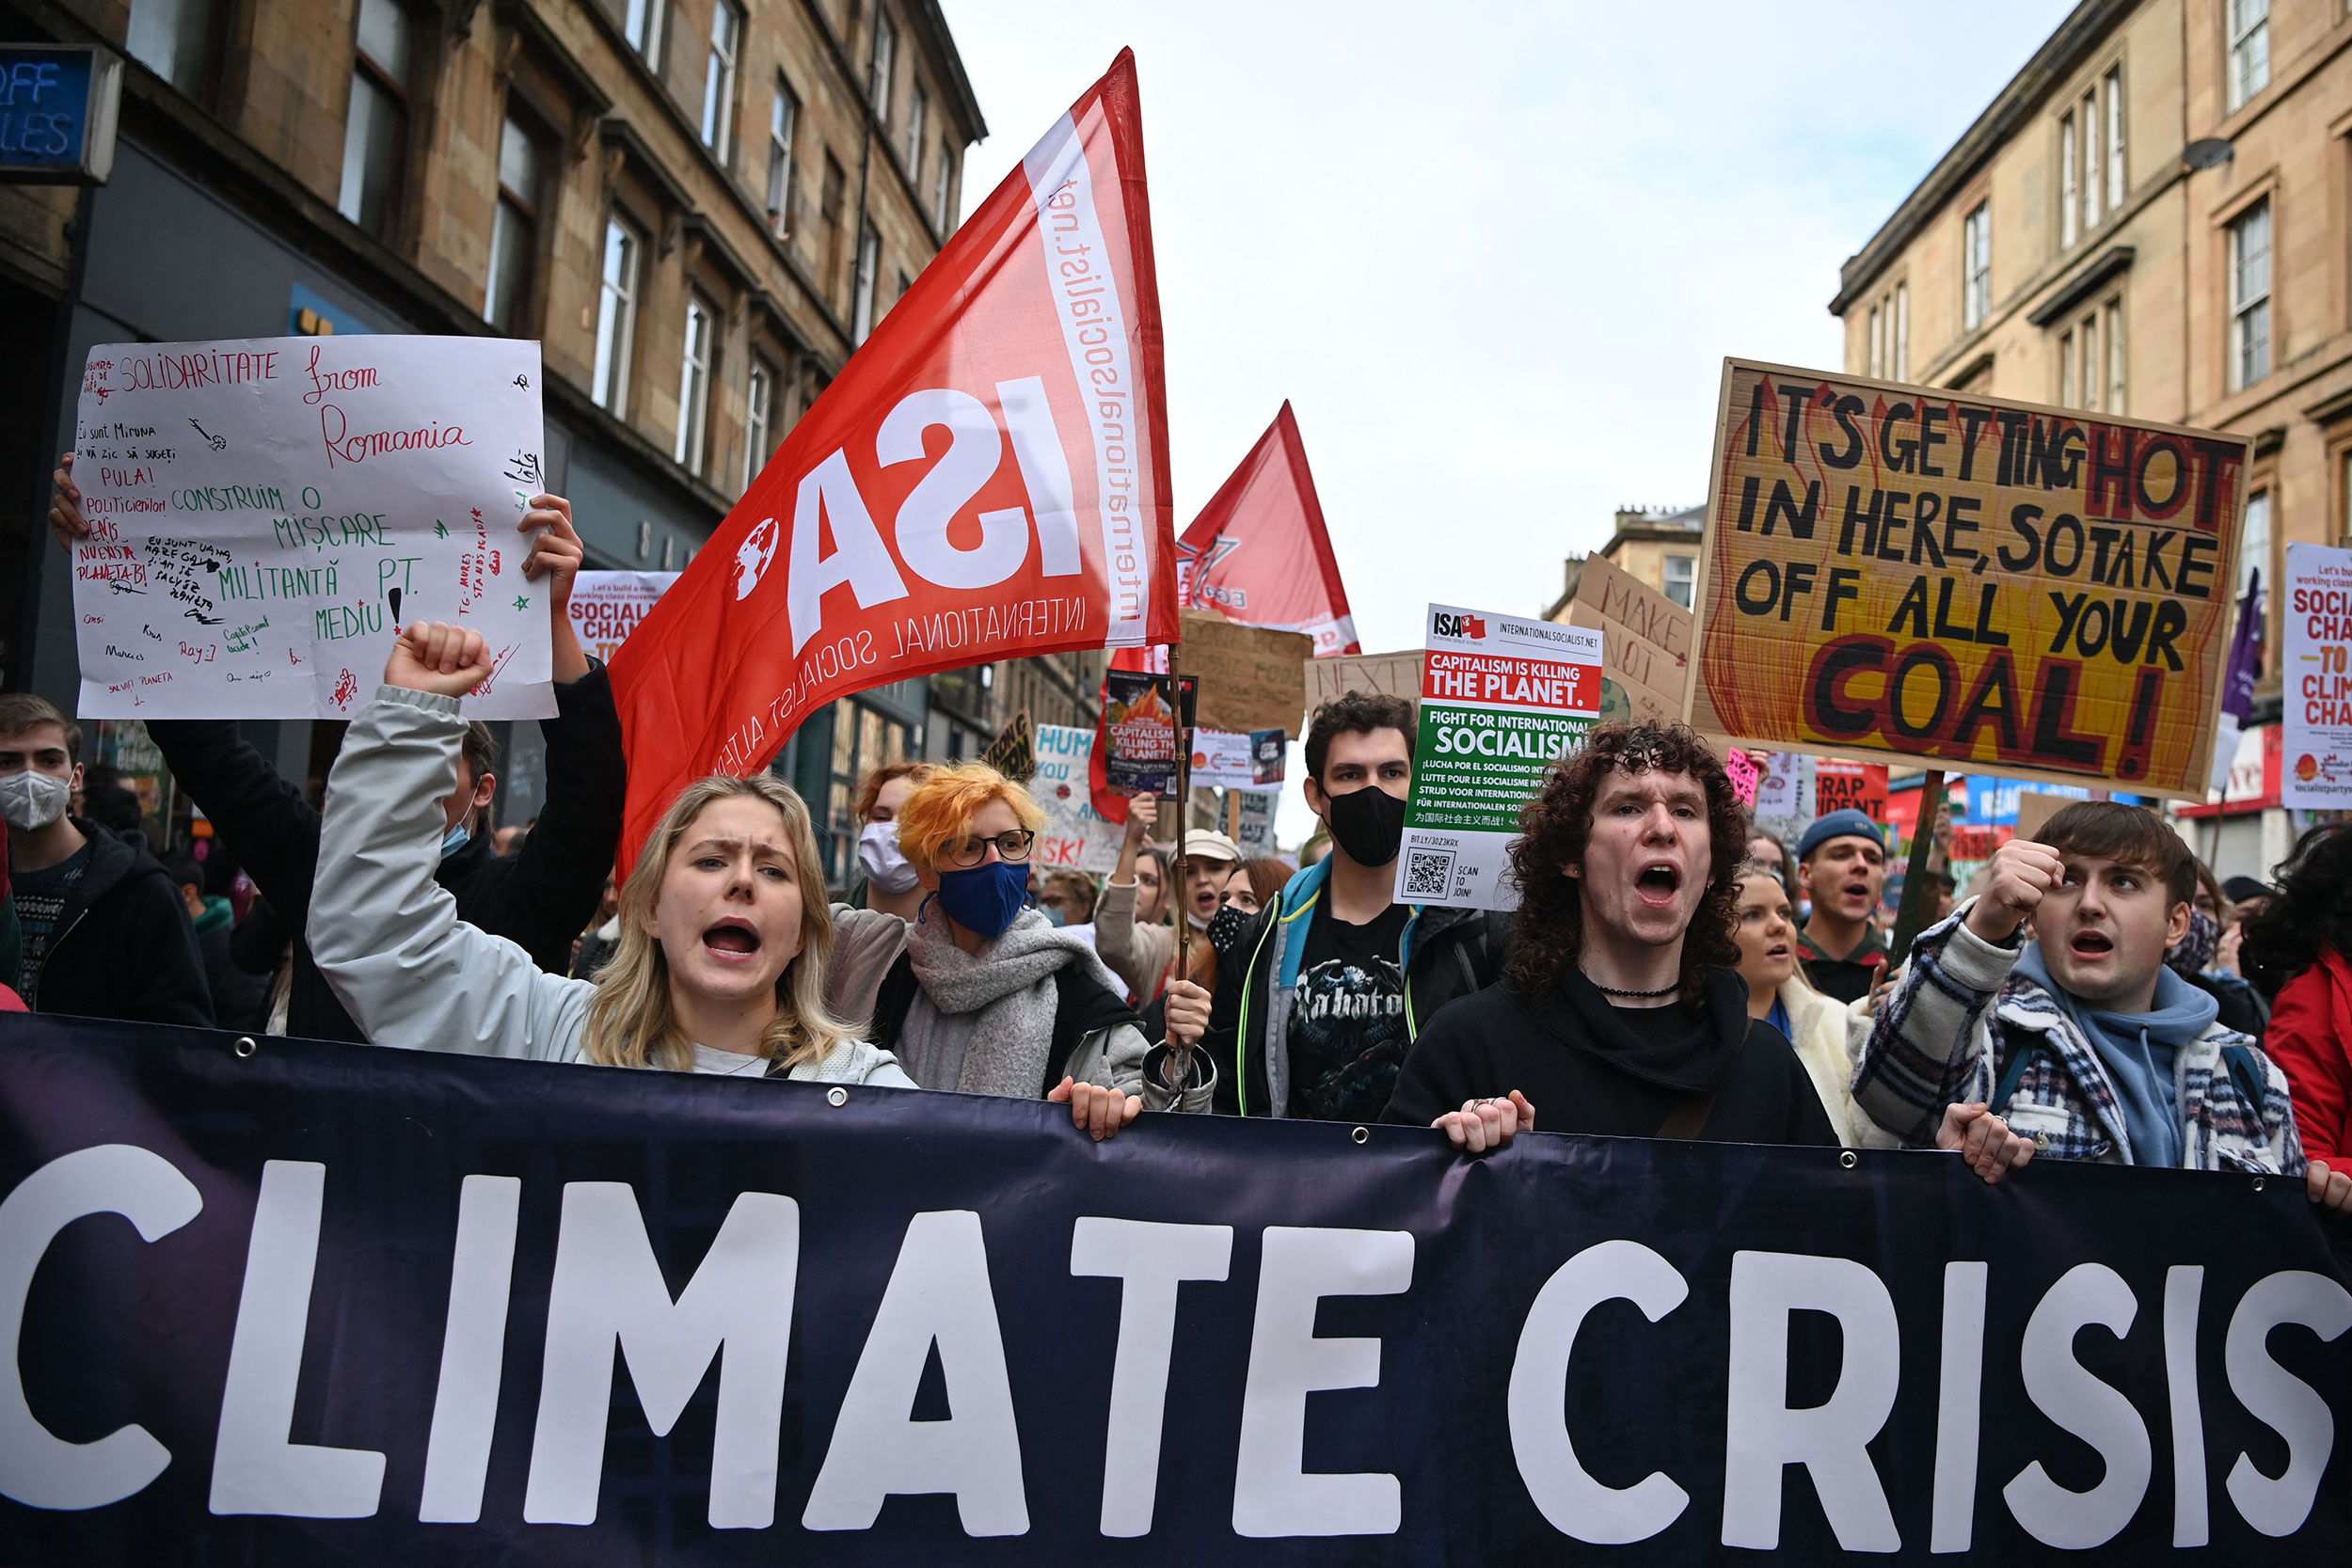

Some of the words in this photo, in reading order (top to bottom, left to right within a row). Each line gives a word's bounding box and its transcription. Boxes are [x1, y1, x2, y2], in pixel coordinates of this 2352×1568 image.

[303, 344, 382, 404] from
[321, 404, 473, 469] Romania
[1744, 384, 1867, 470] IT'S
[2085, 423, 2248, 529] HOT
[101, 467, 155, 488] PULA!
[302, 486, 322, 510] O
[1737, 476, 1821, 540] IN
[1836, 485, 1991, 577] HERE,
[164, 537, 197, 547] SUNT
[378, 557, 422, 600] PT.
[2318, 564, 2340, 576] Let's
[612, 584, 632, 593] build
[2296, 576, 2331, 589] working
[572, 593, 604, 601] working
[1600, 575, 1687, 651] MAKE
[1734, 559, 1861, 632] OFF
[1885, 575, 2010, 647] ALL
[2047, 591, 2189, 673] YOUR
[1434, 611, 1463, 639] ISA
[1499, 622, 1598, 649] INTERNATIONALSOCIALIST.NET
[1601, 621, 1658, 685] NOT
[2320, 645, 2348, 673] TO
[1430, 654, 1514, 675] CAPITALISM
[1516, 660, 1528, 676] IS
[1530, 663, 1581, 680] KILLING
[1429, 669, 1477, 698] THE
[1484, 673, 1583, 707] PLANET.
[1802, 632, 2166, 783] COAL!
[1429, 710, 1468, 725] FIGHT
[1470, 713, 1495, 728] FOR
[1110, 726, 1174, 739] CAPITALISM
[1116, 736, 1158, 749] KILLING
[1125, 748, 1169, 760] PLANET!
[1454, 761, 1471, 770] POR
[1472, 762, 1483, 770] EL
[1483, 762, 1531, 774] SOCIALISMO
[1421, 773, 1446, 784] LUTTE
[1447, 774, 1470, 784] POUR
[1471, 775, 1482, 784] LE
[1482, 776, 1529, 787] SOCIALISME
[1418, 785, 1447, 796] STRIJD
[1448, 787, 1473, 797] VOOR
[1416, 797, 1432, 807] FÜR
[1433, 800, 1505, 811] INTERNATIONALEN
[1457, 865, 1479, 876] SCAN
[1453, 887, 1471, 897] JOIN!
[1455, 877, 1465, 886] TO
[0, 1143, 1416, 1540] CLIMATE
[1507, 1239, 2352, 1553] CRISIS
